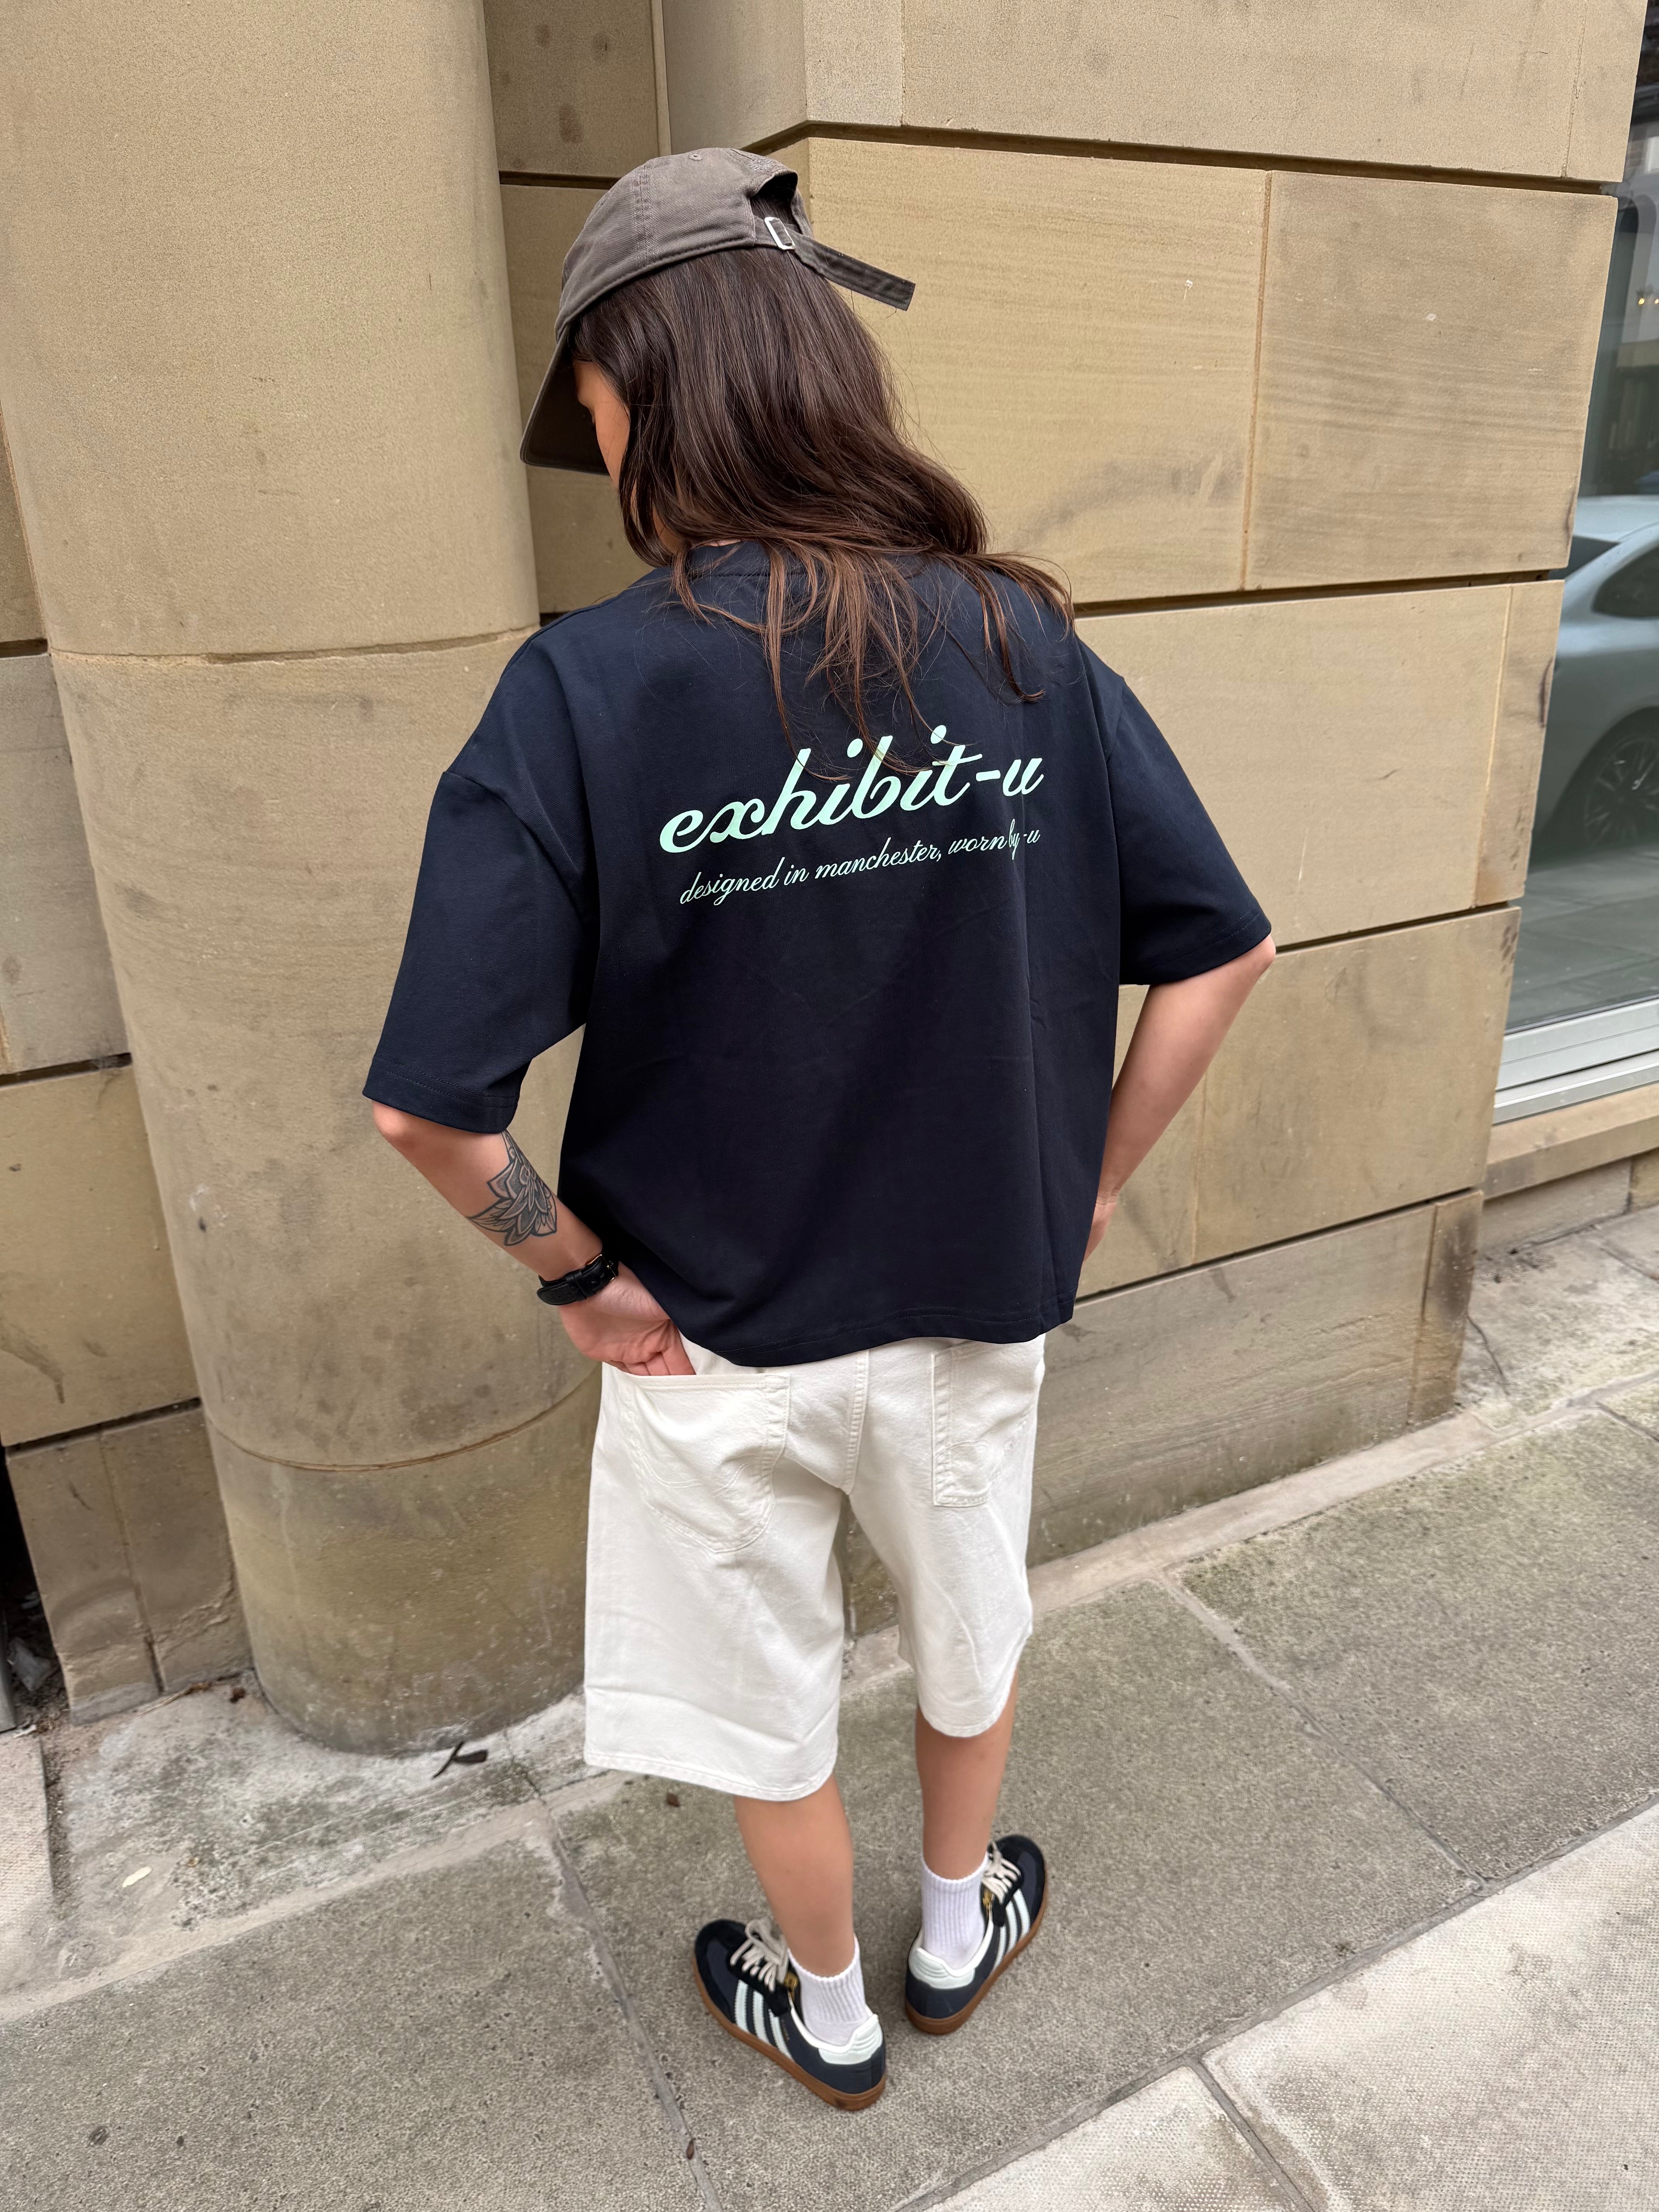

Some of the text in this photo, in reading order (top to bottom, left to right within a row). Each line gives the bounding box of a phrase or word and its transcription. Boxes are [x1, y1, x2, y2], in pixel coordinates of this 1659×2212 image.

[659, 724, 1044, 854] exhibit-u
[679, 856, 785, 906] designed
[784, 863, 810, 886] in
[814, 836, 943, 880] manchester,
[947, 835, 1008, 855] worn
